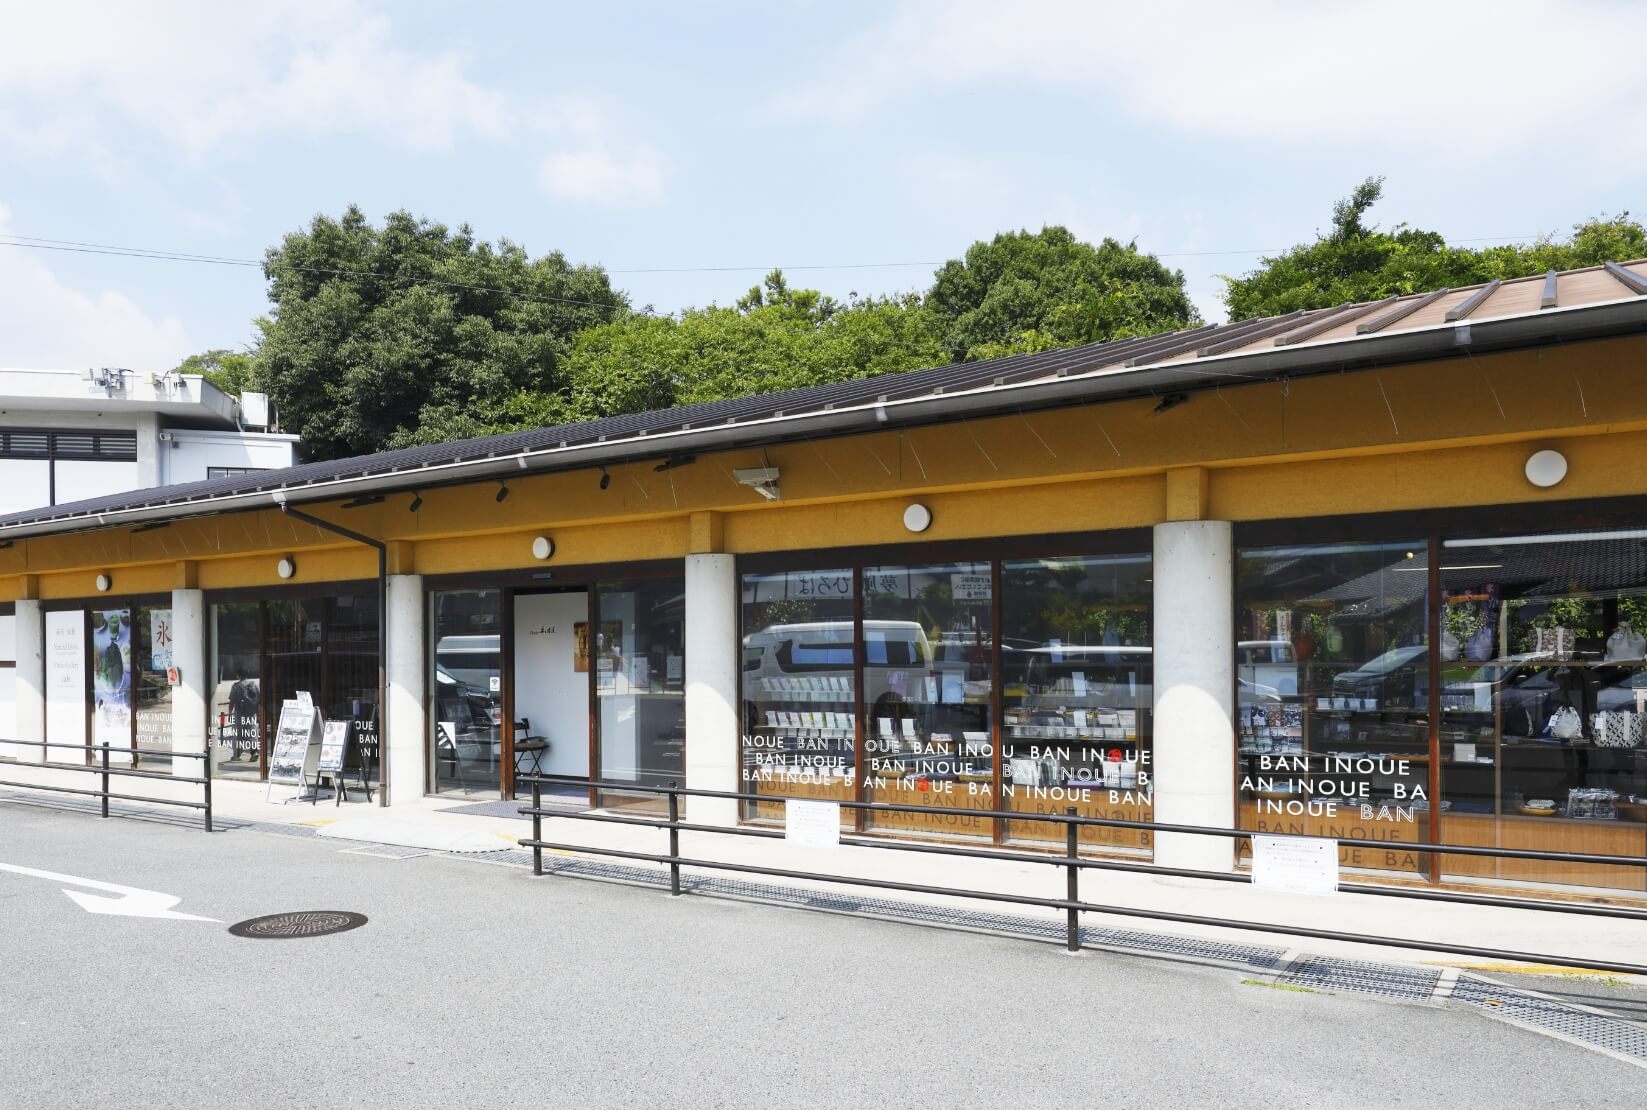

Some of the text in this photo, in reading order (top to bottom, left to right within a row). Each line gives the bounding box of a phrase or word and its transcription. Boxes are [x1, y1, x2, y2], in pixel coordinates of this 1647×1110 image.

[742, 735, 784, 748] NOUE
[797, 736, 829, 750] BAN
[913, 741, 949, 756] BAN
[1030, 745, 1070, 761] BAN
[756, 752, 786, 766] BAN
[794, 754, 846, 768] INOUE
[871, 758, 905, 772] BAN
[916, 760, 973, 776] INOUE
[1052, 766, 1120, 784] INOUE
[1138, 771, 1148, 786] B
[1260, 755, 1410, 776] BAN INOUE
[742, 768, 772, 782] BAN
[780, 771, 831, 786] INOUE
[1026, 785, 1091, 803] INOUE
[1109, 790, 1152, 806] BAN
[1240, 776, 1427, 800] AN INOUE BA
[1257, 798, 1414, 823] INOUE BAN
